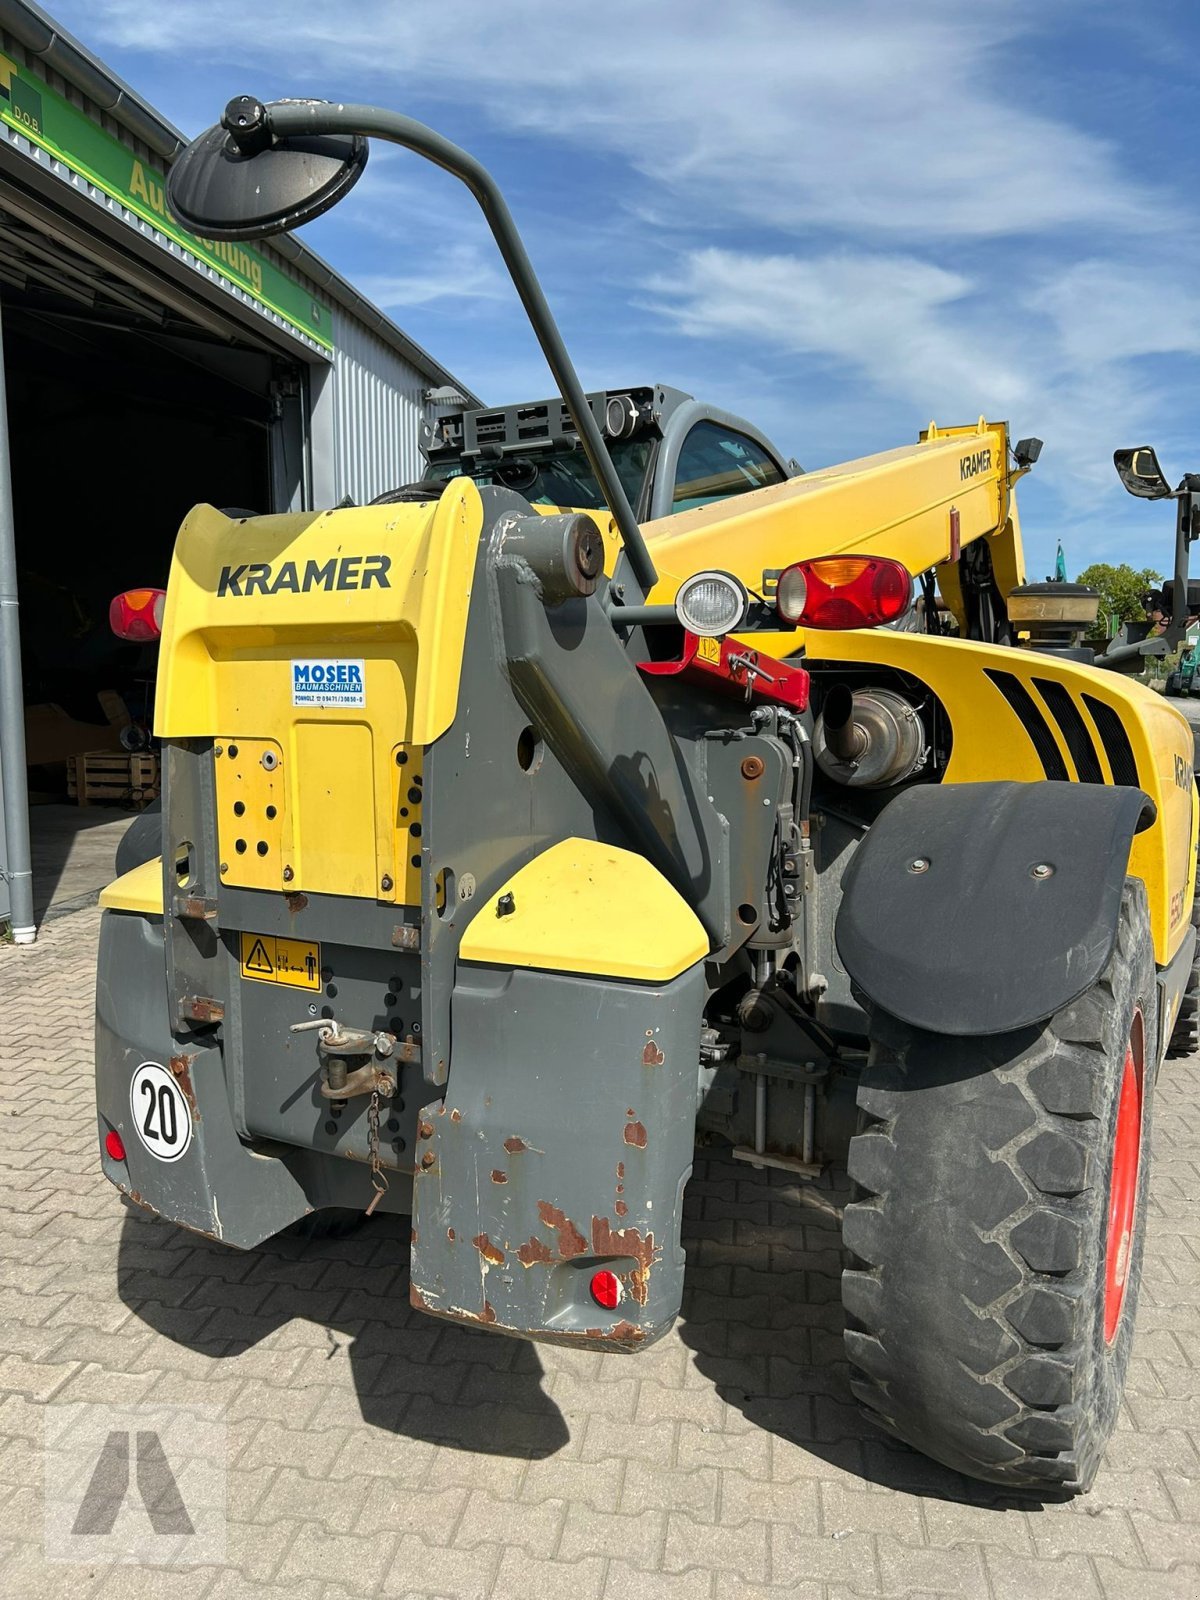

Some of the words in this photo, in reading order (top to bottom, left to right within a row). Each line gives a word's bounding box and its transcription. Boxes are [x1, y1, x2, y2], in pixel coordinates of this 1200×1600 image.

[959, 448, 992, 481] KRAMER
[217, 555, 392, 598] KRAMER
[294, 665, 362, 683] MOSER
[295, 683, 362, 692] BAUMASCHINEN
[141, 1079, 177, 1145] 20
